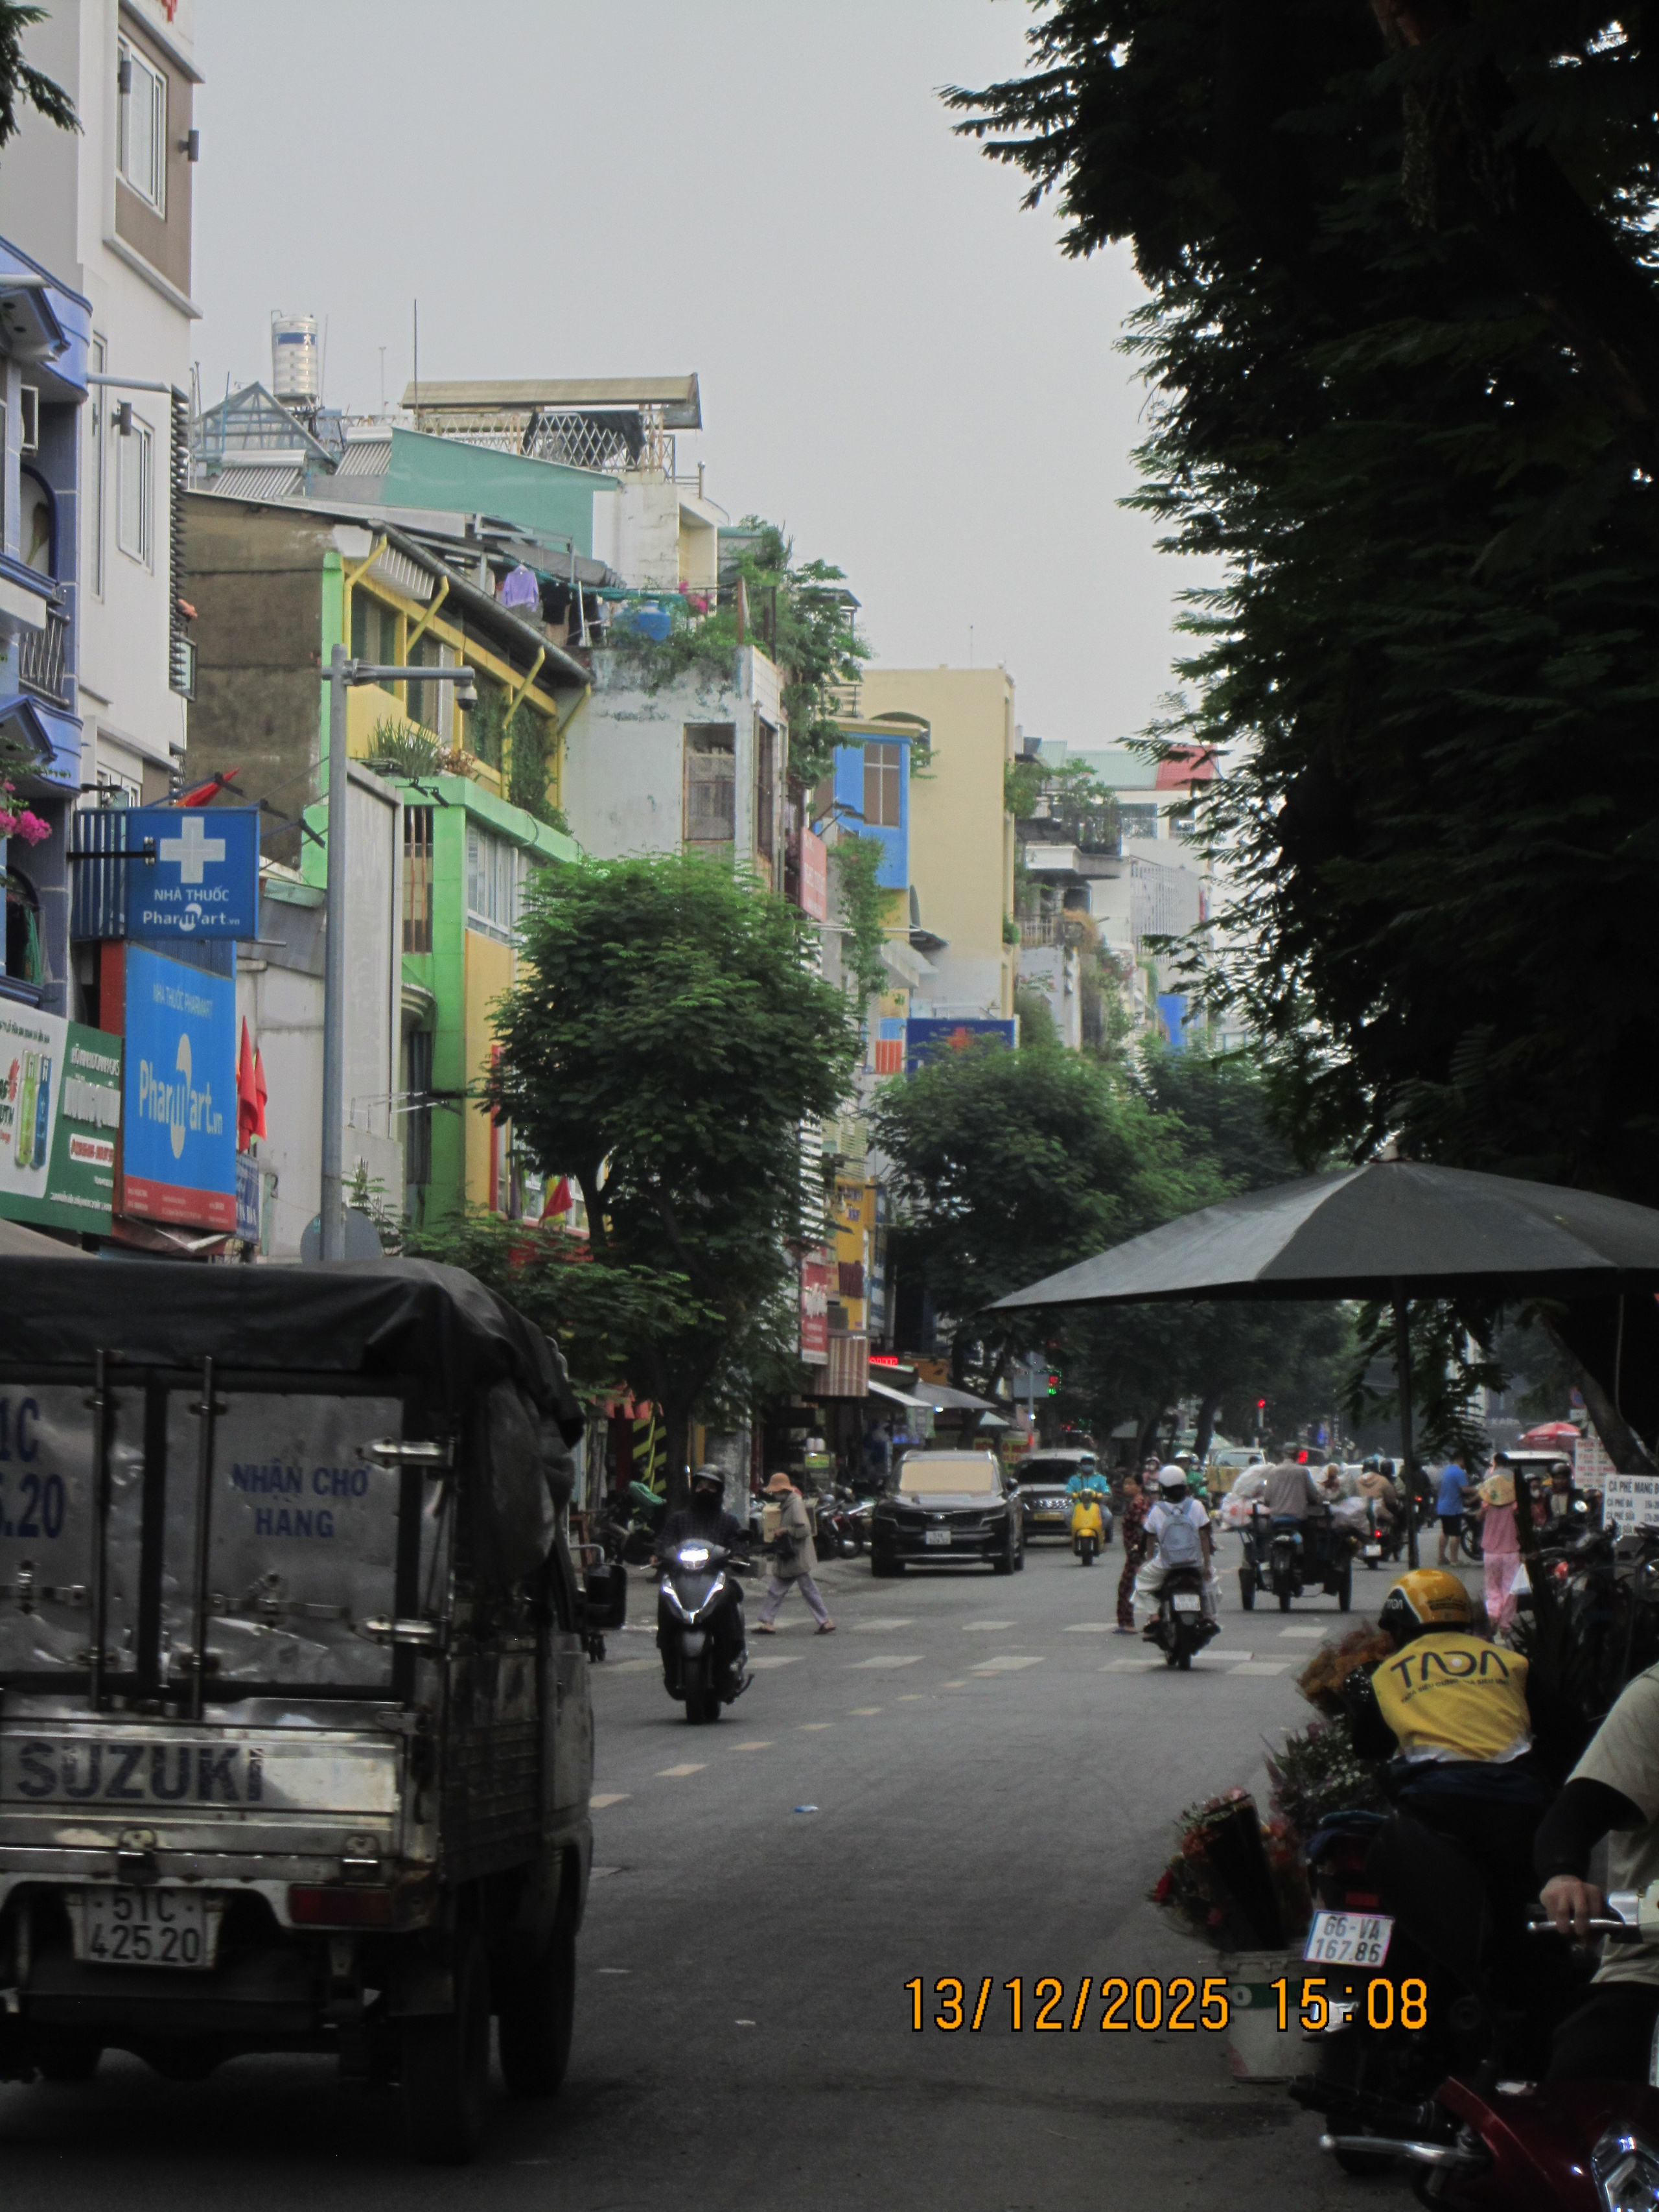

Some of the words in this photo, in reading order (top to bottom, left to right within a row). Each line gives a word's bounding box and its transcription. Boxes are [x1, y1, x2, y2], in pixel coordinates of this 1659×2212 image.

[154, 887, 182, 901] NHÀ
[186, 885, 229, 902] THUỐC
[17, 1742, 264, 1802] SUZUKI
[113, 1889, 176, 1923] 51C
[1323, 1915, 1380, 1940] 66-VA
[1315, 1938, 1382, 1963] 167.86
